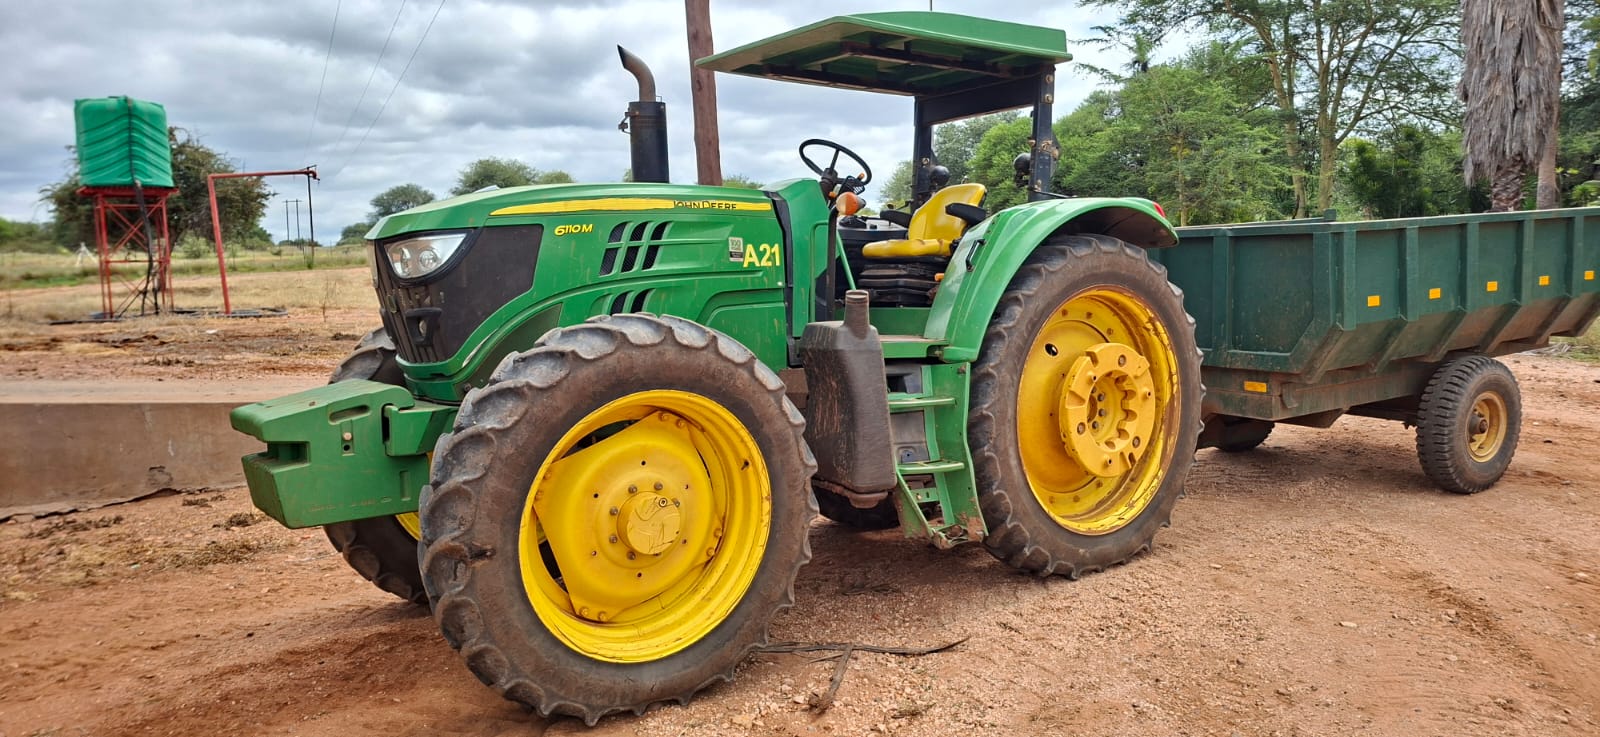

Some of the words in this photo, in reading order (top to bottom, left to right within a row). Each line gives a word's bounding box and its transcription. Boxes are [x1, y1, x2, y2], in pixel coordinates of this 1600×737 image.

[673, 200, 700, 209] JOHN
[702, 200, 737, 209] DEERE
[743, 243, 780, 267] A21
